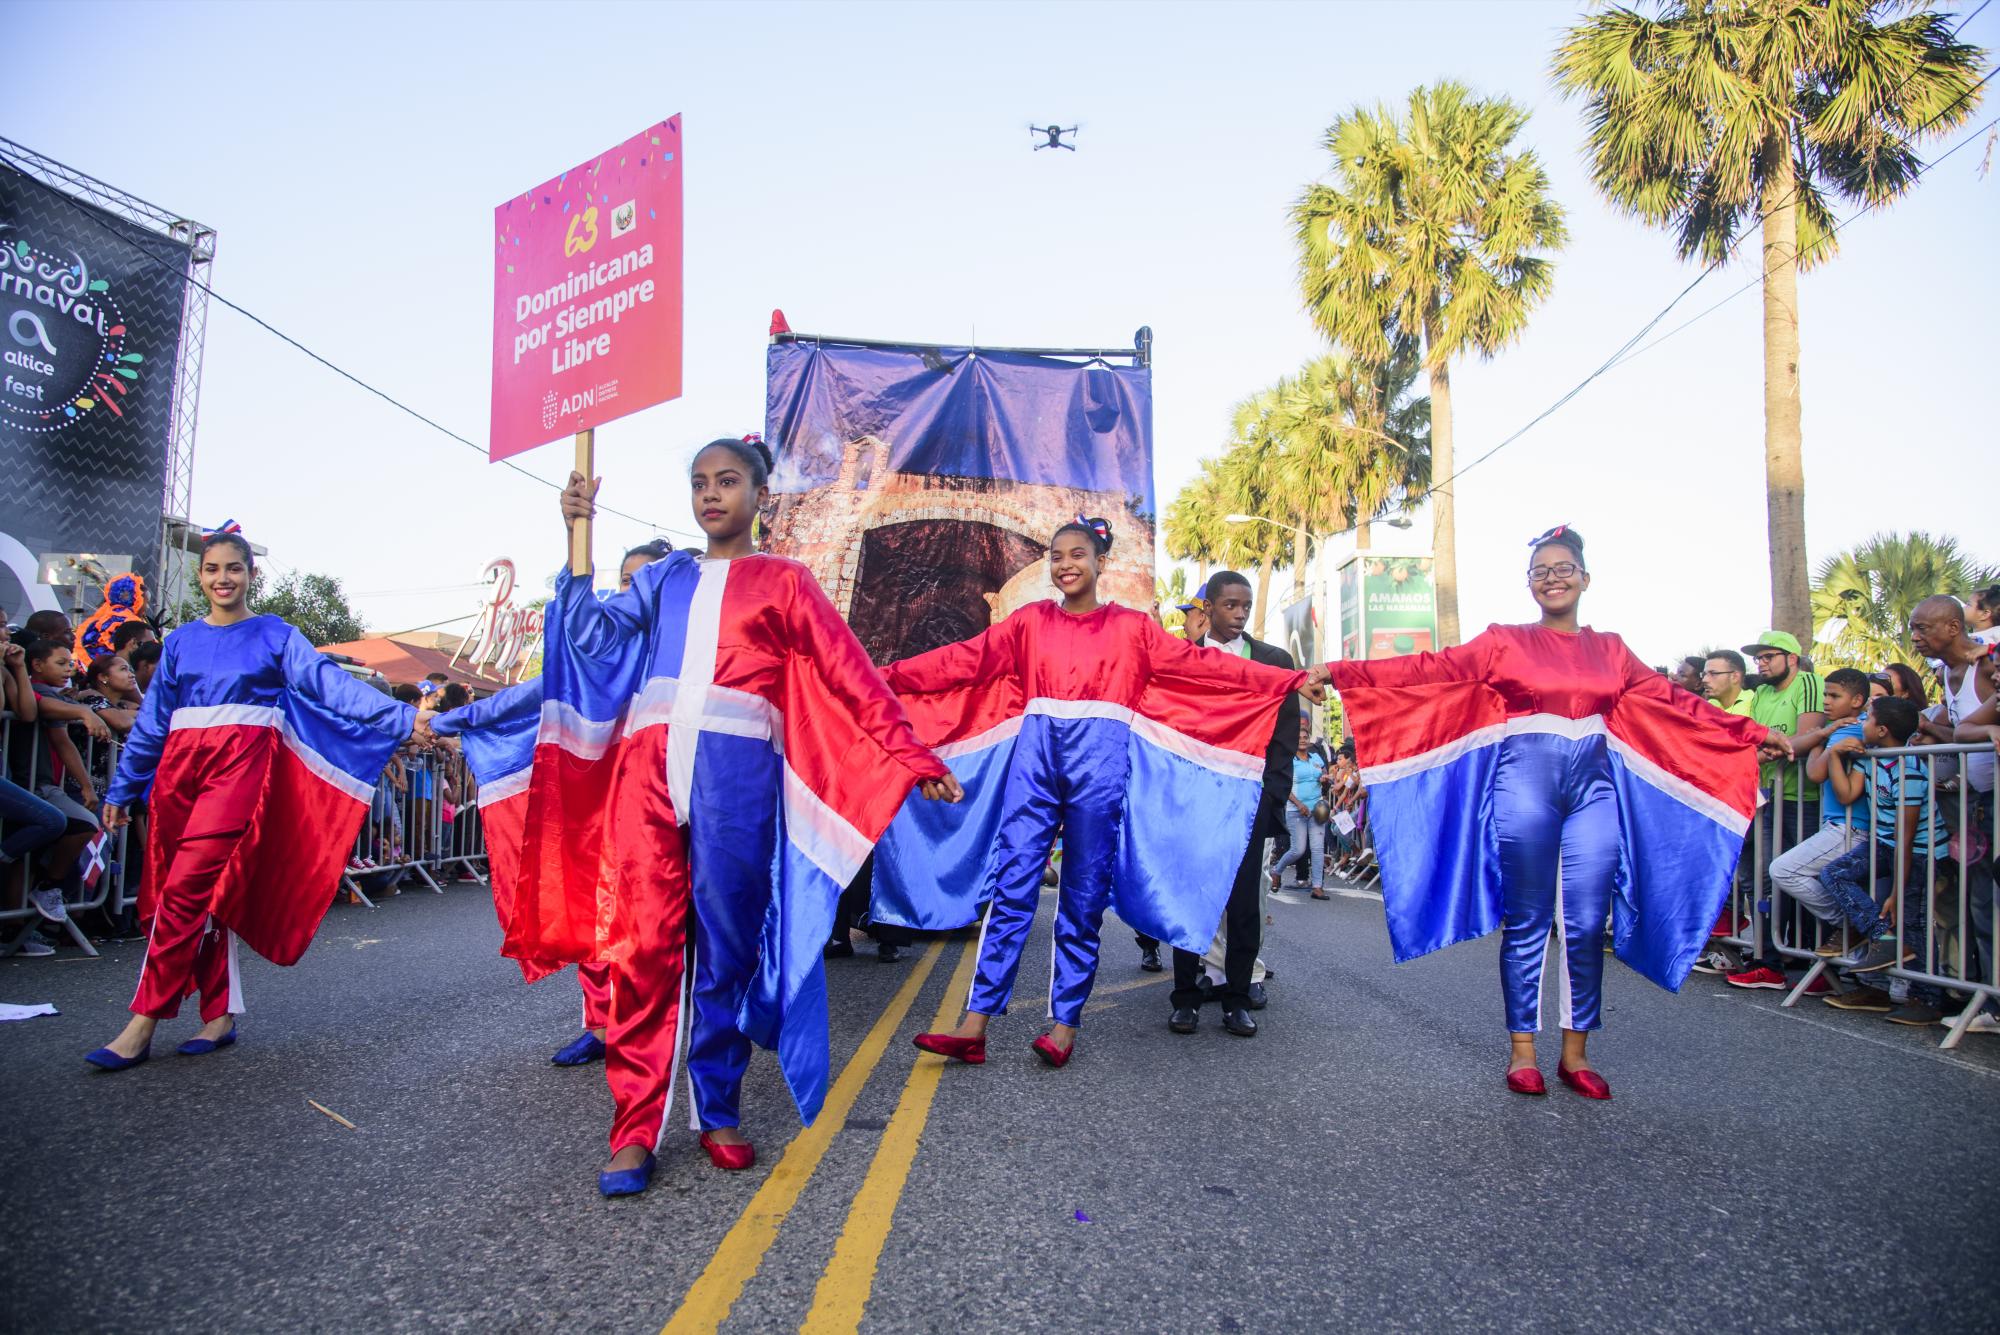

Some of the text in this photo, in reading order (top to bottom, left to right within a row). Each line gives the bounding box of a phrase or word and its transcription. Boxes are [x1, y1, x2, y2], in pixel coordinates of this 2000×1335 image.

[564, 205, 599, 258] 63
[516, 243, 653, 322] Dominicana
[514, 278, 655, 365] por Siempre
[4, 350, 55, 377] altice
[552, 333, 611, 375] Libre
[5, 375, 45, 402] fest
[560, 388, 595, 417] ADN
[1368, 592, 1431, 604] AMAMOS
[1368, 604, 1385, 612] LAS
